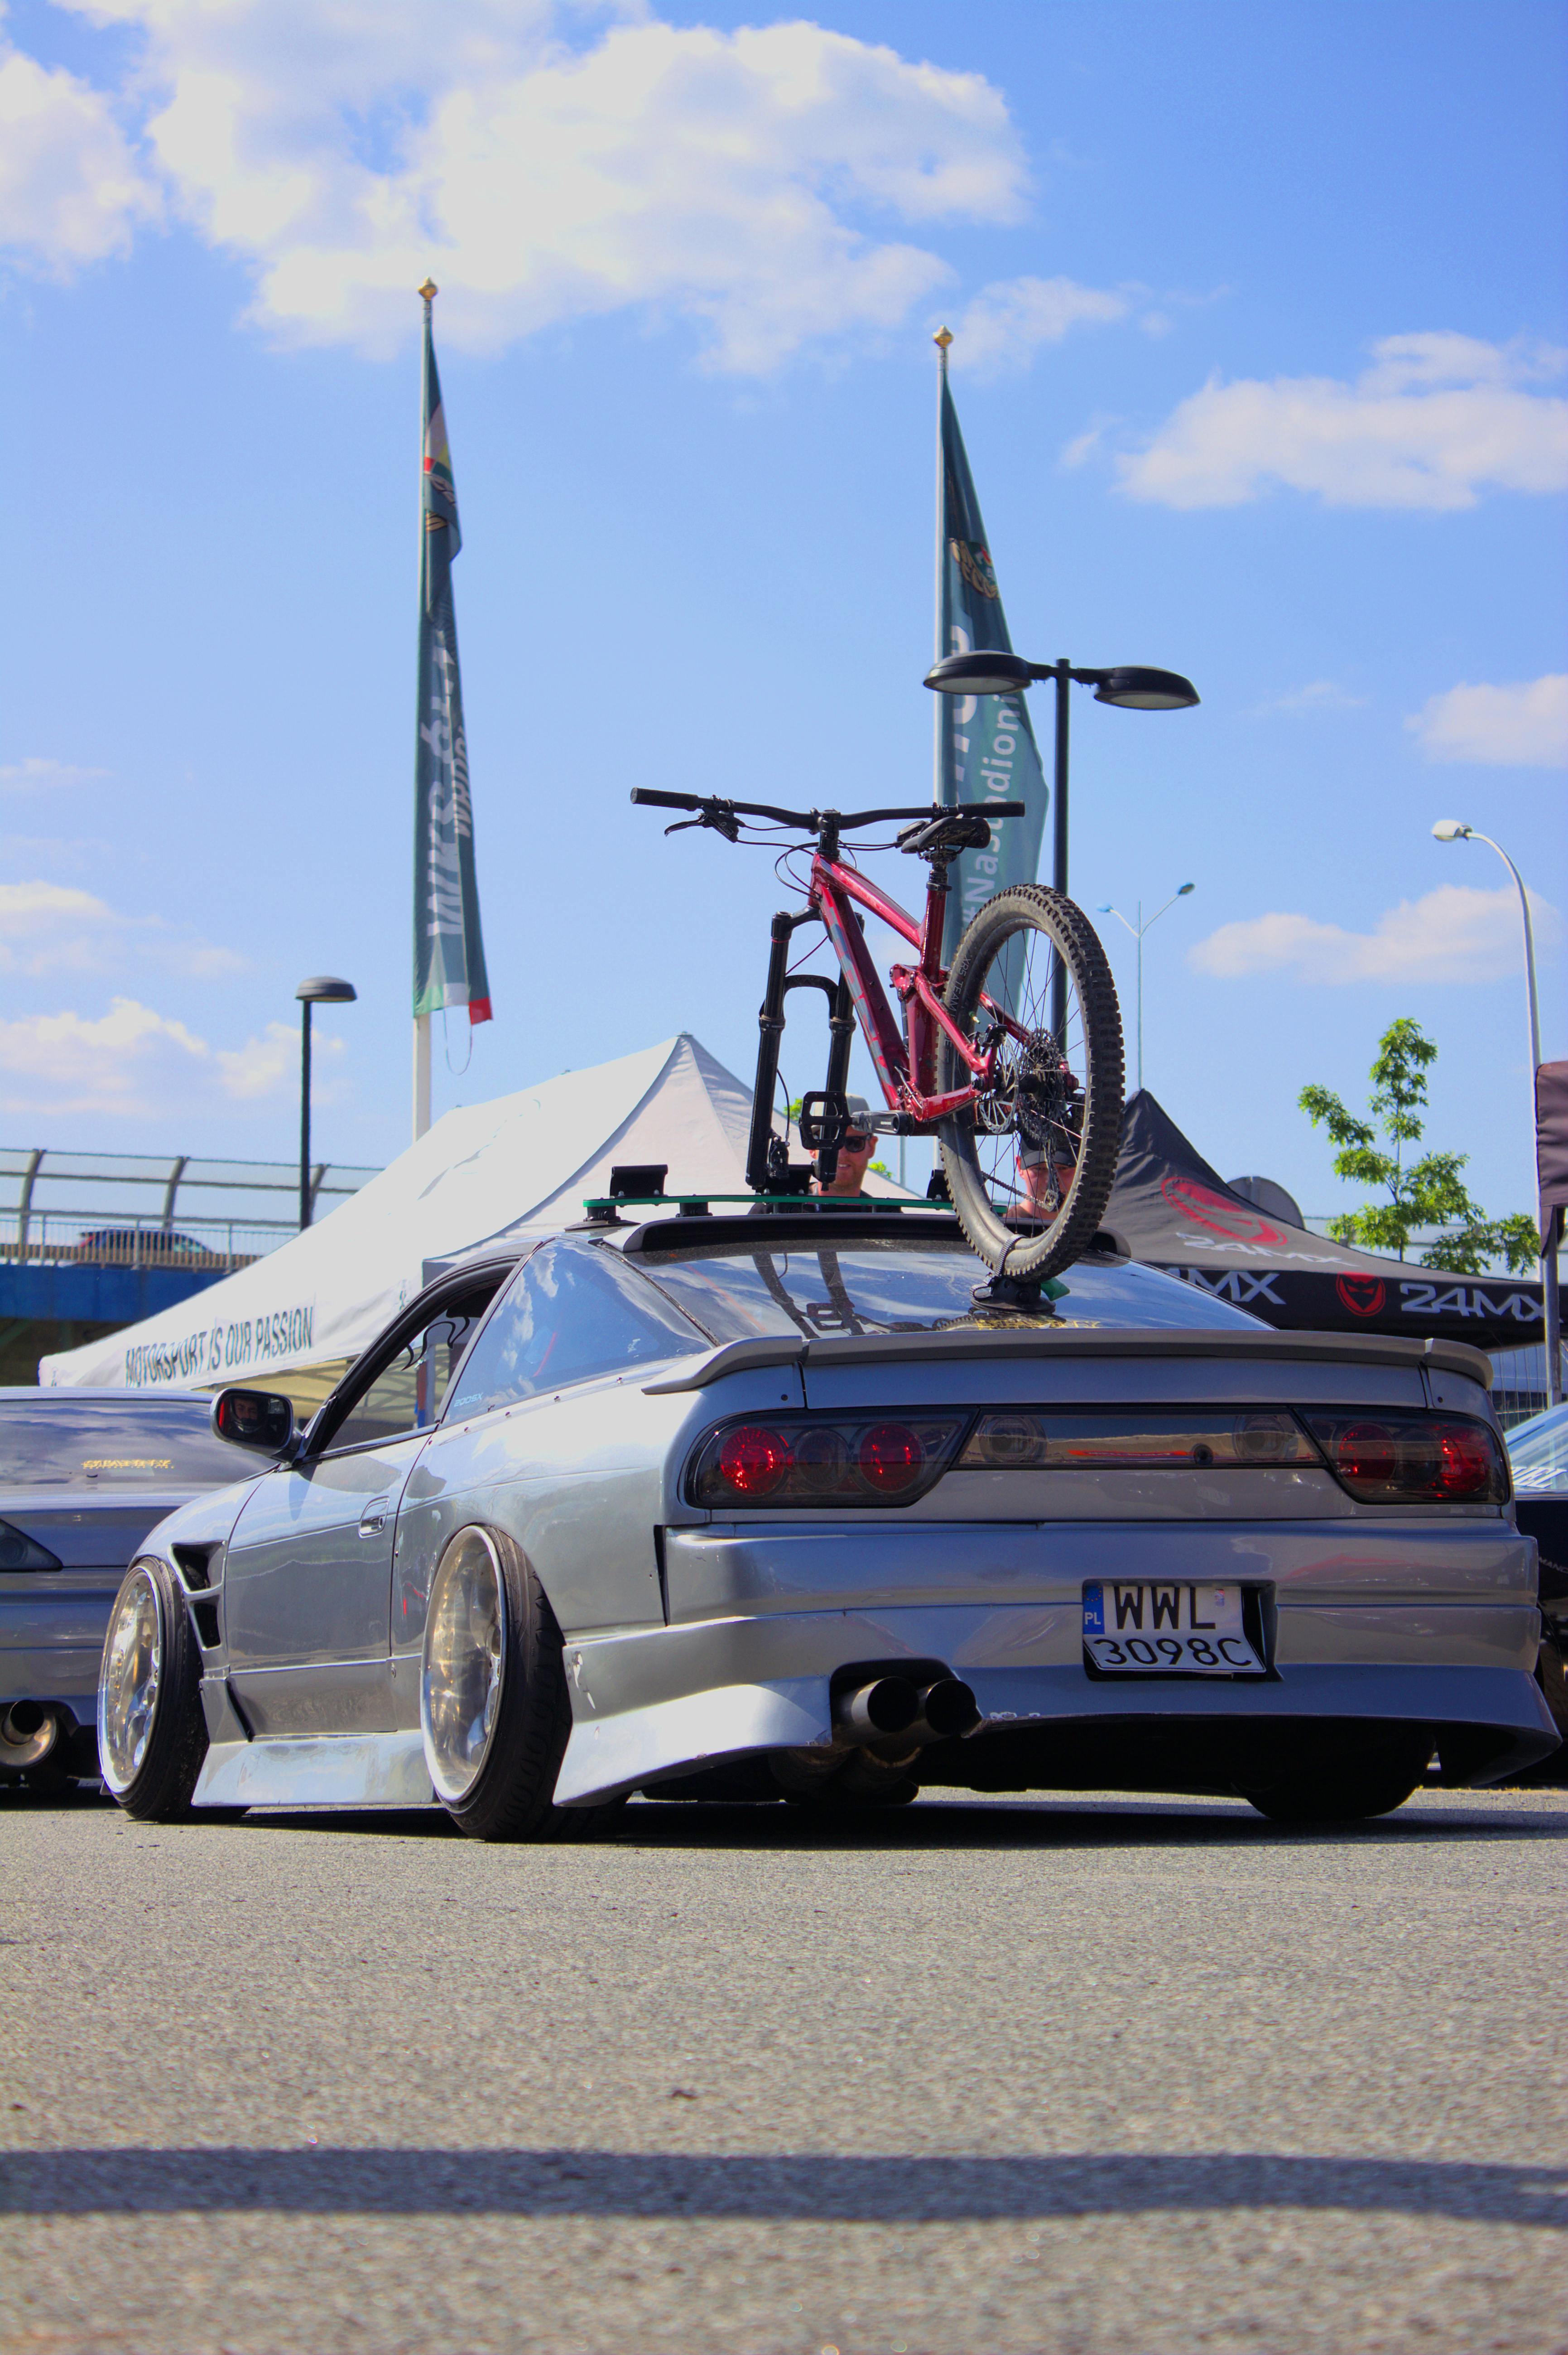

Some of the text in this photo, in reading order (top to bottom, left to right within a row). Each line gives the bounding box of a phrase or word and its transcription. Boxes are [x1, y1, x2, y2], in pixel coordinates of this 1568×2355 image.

[958, 955, 971, 977] XR5
[949, 980, 963, 1011] TEAM
[1176, 1232, 1362, 1267] 24MX
[1166, 1269, 1287, 1305] MX
[1399, 1282, 1564, 1323] 24MX
[125, 1306, 313, 1388] MOTORSPORT IS OUR PASSION
[453, 1392, 484, 1408] 200SX
[1084, 1612, 1101, 1626] PL
[1113, 1586, 1216, 1630] WWL
[1093, 1637, 1252, 1667] 3098C
